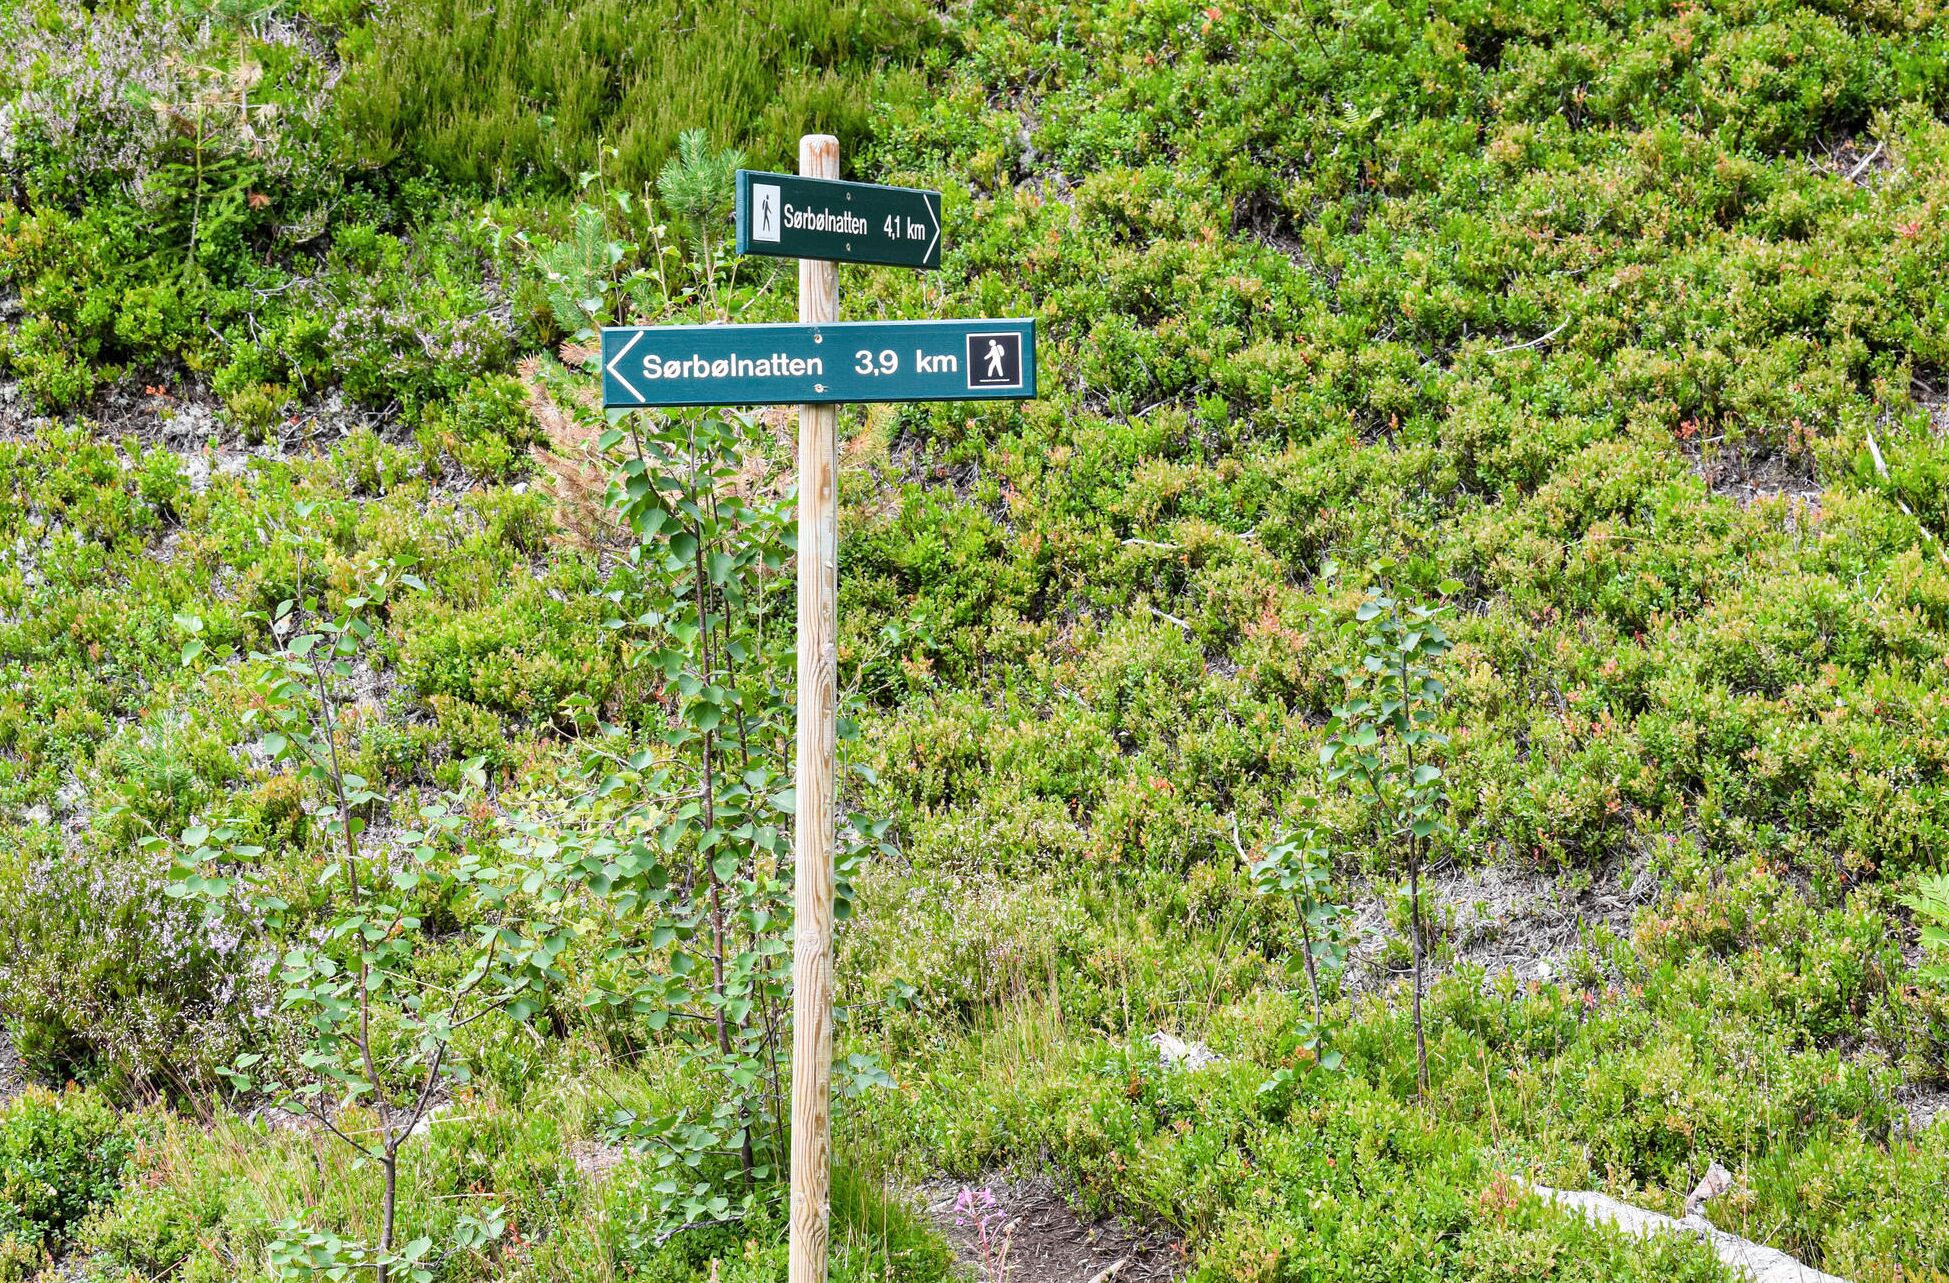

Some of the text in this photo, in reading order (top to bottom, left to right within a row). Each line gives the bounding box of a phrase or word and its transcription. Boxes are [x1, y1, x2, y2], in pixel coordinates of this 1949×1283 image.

[784, 203, 926, 240] Sørbølnatten 4,1 km
[642, 349, 958, 379] Sørbølnatten 3,9 km
